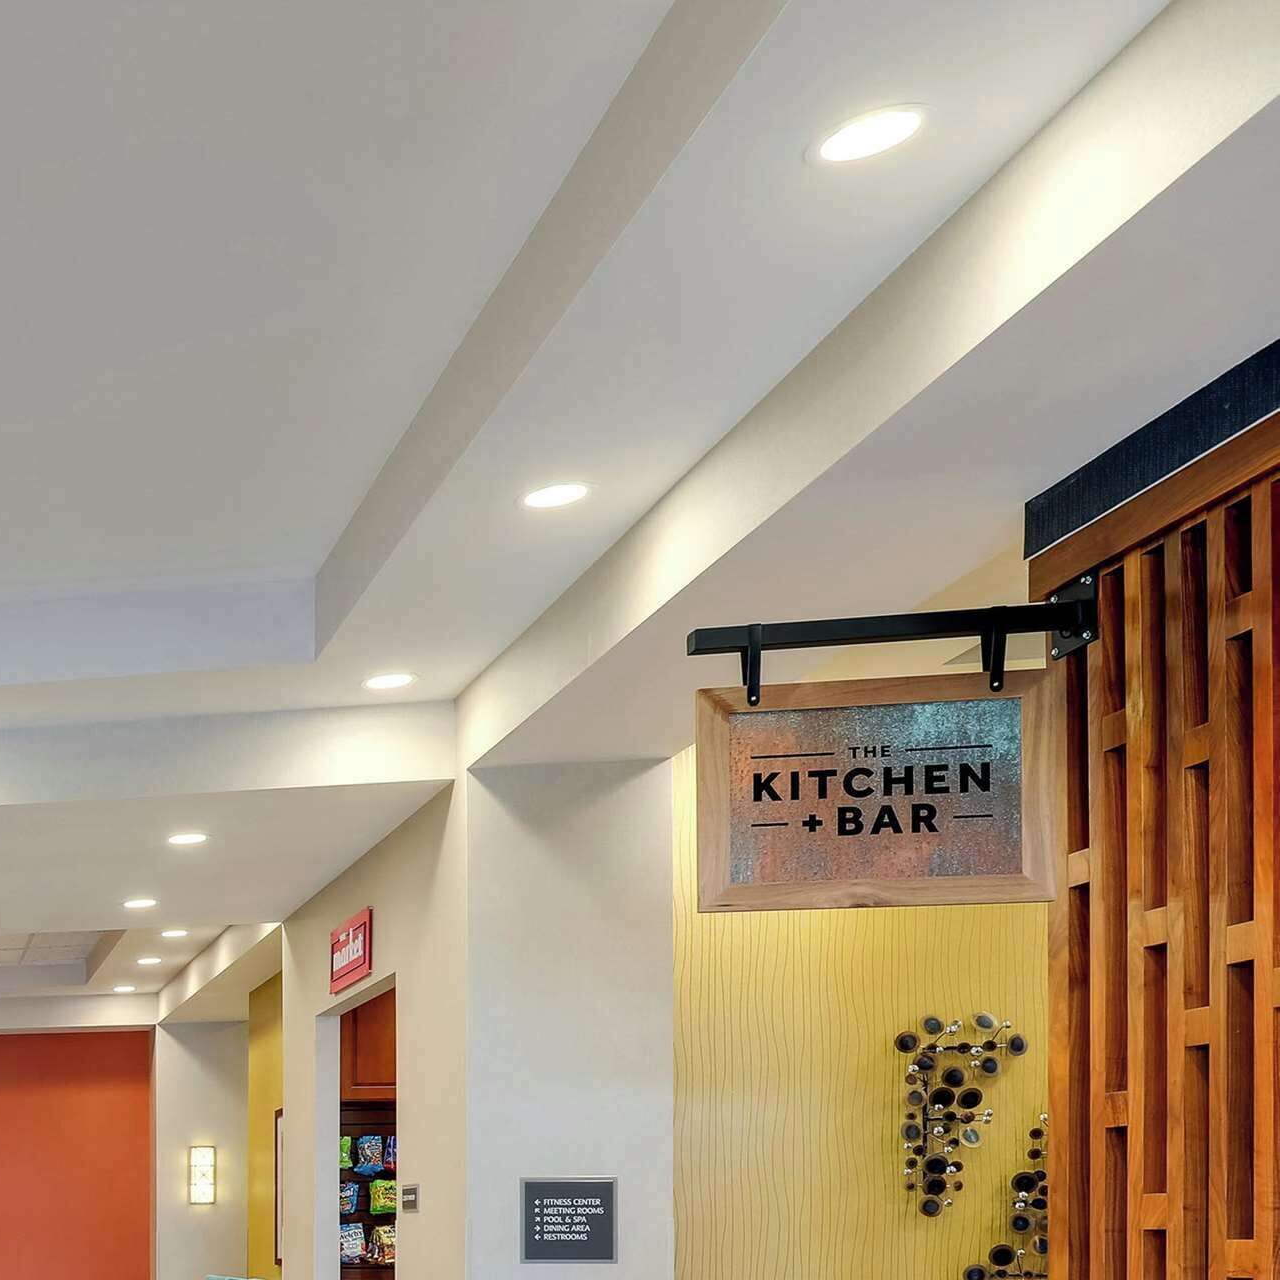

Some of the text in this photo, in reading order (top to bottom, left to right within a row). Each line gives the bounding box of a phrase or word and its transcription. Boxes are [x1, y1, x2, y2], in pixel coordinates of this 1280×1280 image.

[848, 746, 892, 759] THE
[752, 762, 991, 801] KITCHEN
[837, 803, 940, 837] BAR
[333, 928, 363, 971] market
